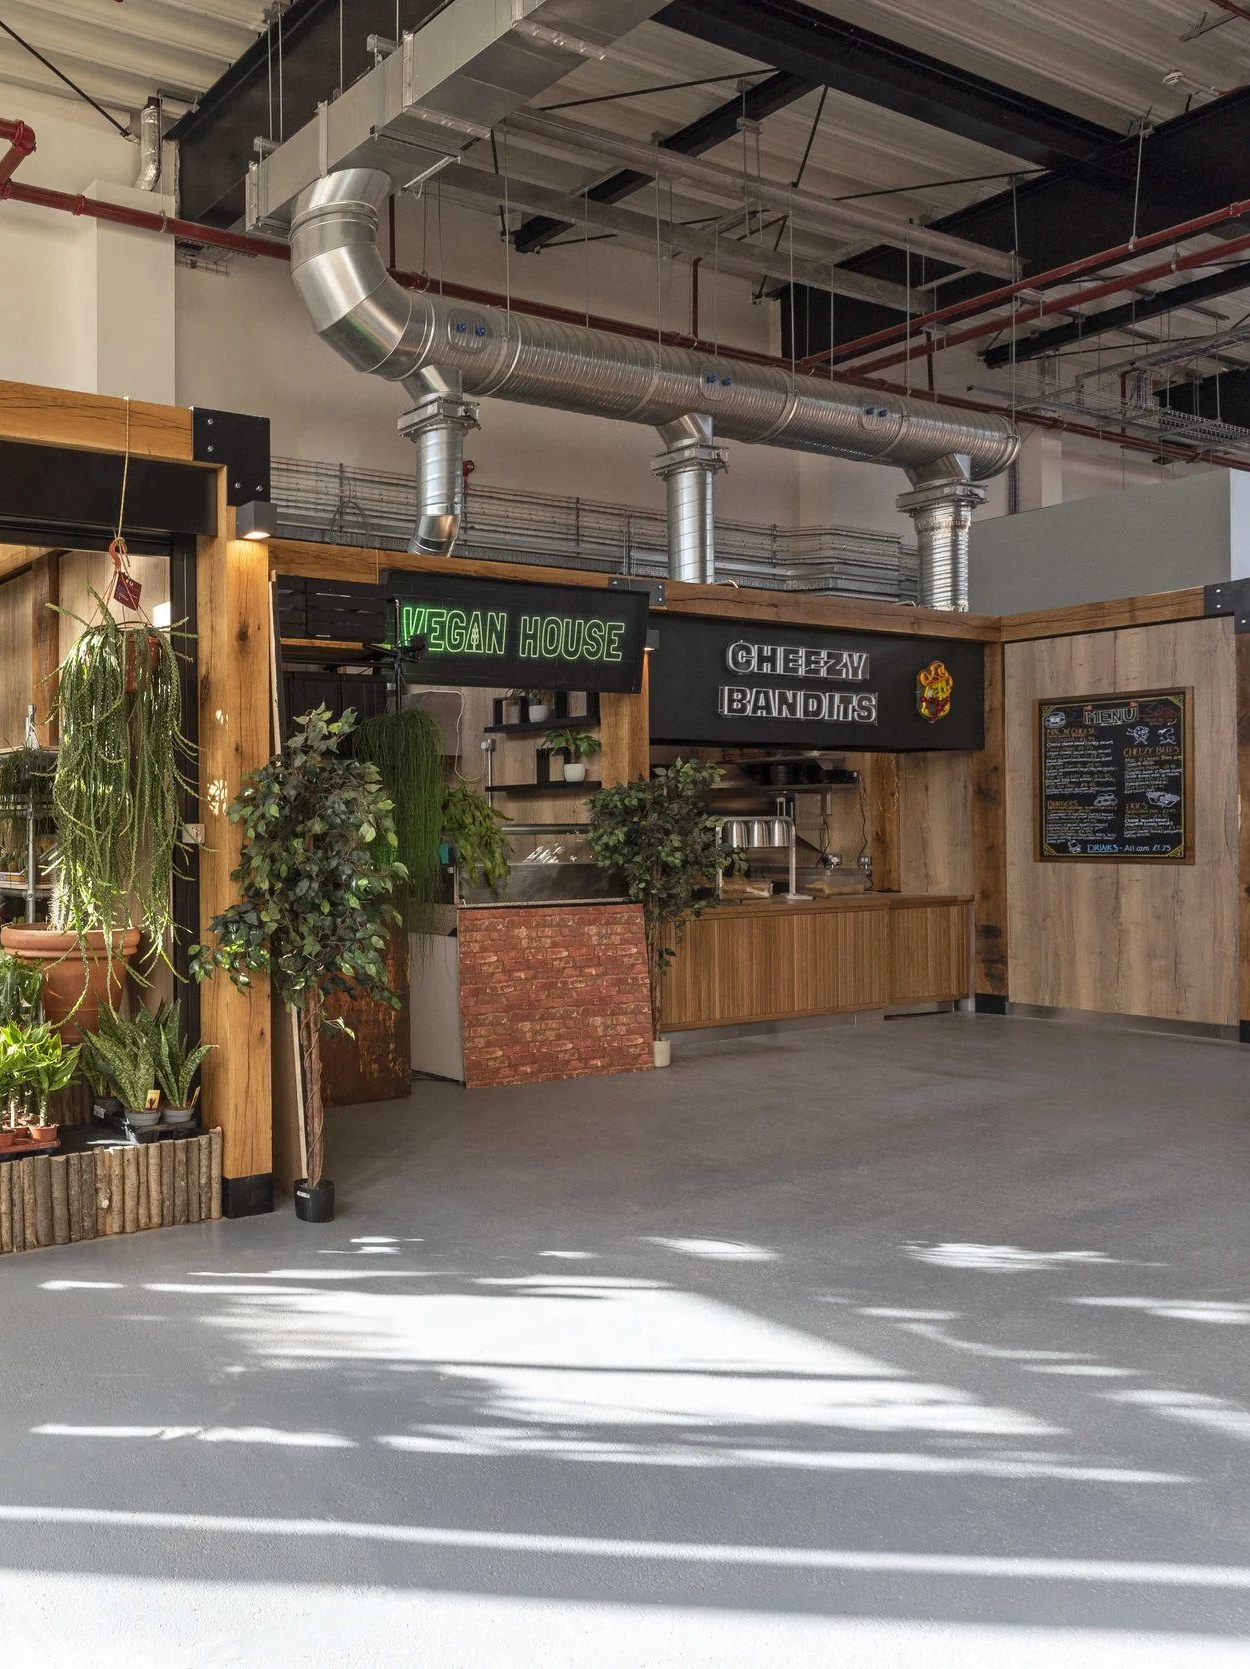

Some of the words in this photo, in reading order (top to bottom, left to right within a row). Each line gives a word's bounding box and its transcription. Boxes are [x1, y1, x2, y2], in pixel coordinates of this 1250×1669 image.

[403, 607, 507, 655] VEGAN
[519, 616, 625, 661] HOUSE
[727, 641, 868, 680] CHEEZY
[723, 685, 877, 723] BANDITS
[1085, 708, 1137, 725] MENU
[1087, 844, 1119, 852] DRINKS
